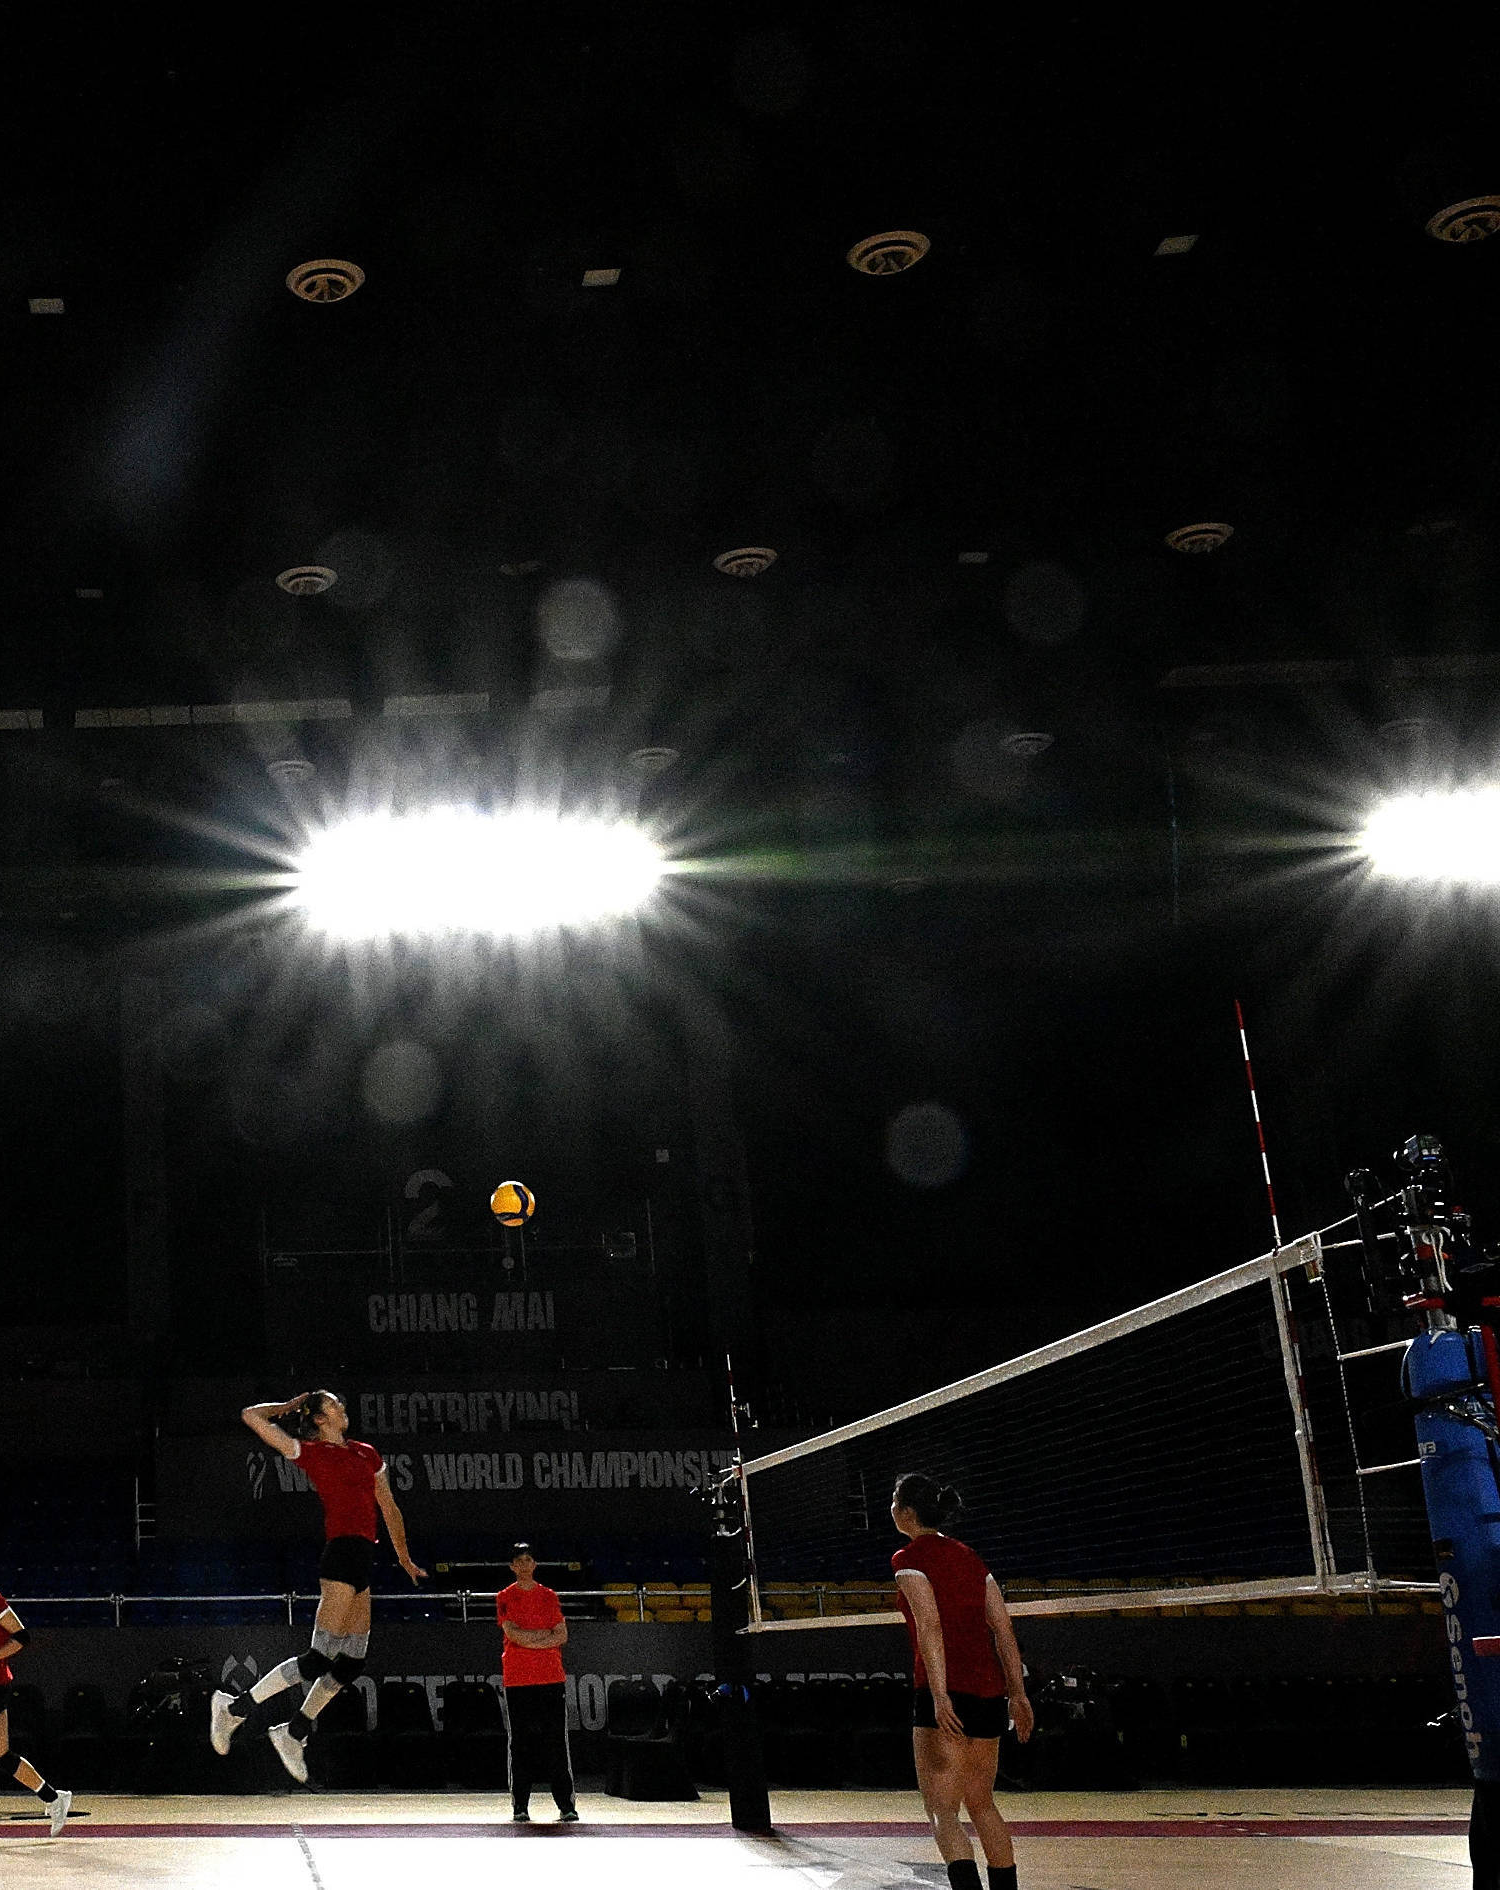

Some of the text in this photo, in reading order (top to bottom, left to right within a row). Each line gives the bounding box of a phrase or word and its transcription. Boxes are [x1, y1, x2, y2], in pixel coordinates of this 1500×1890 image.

[368, 1291, 555, 1332] CHIANG MAI
[360, 1391, 580, 1432] ELECTRIFYING!
[423, 1452, 524, 1490] WORLD
[1446, 1613, 1482, 1759] Senoh
